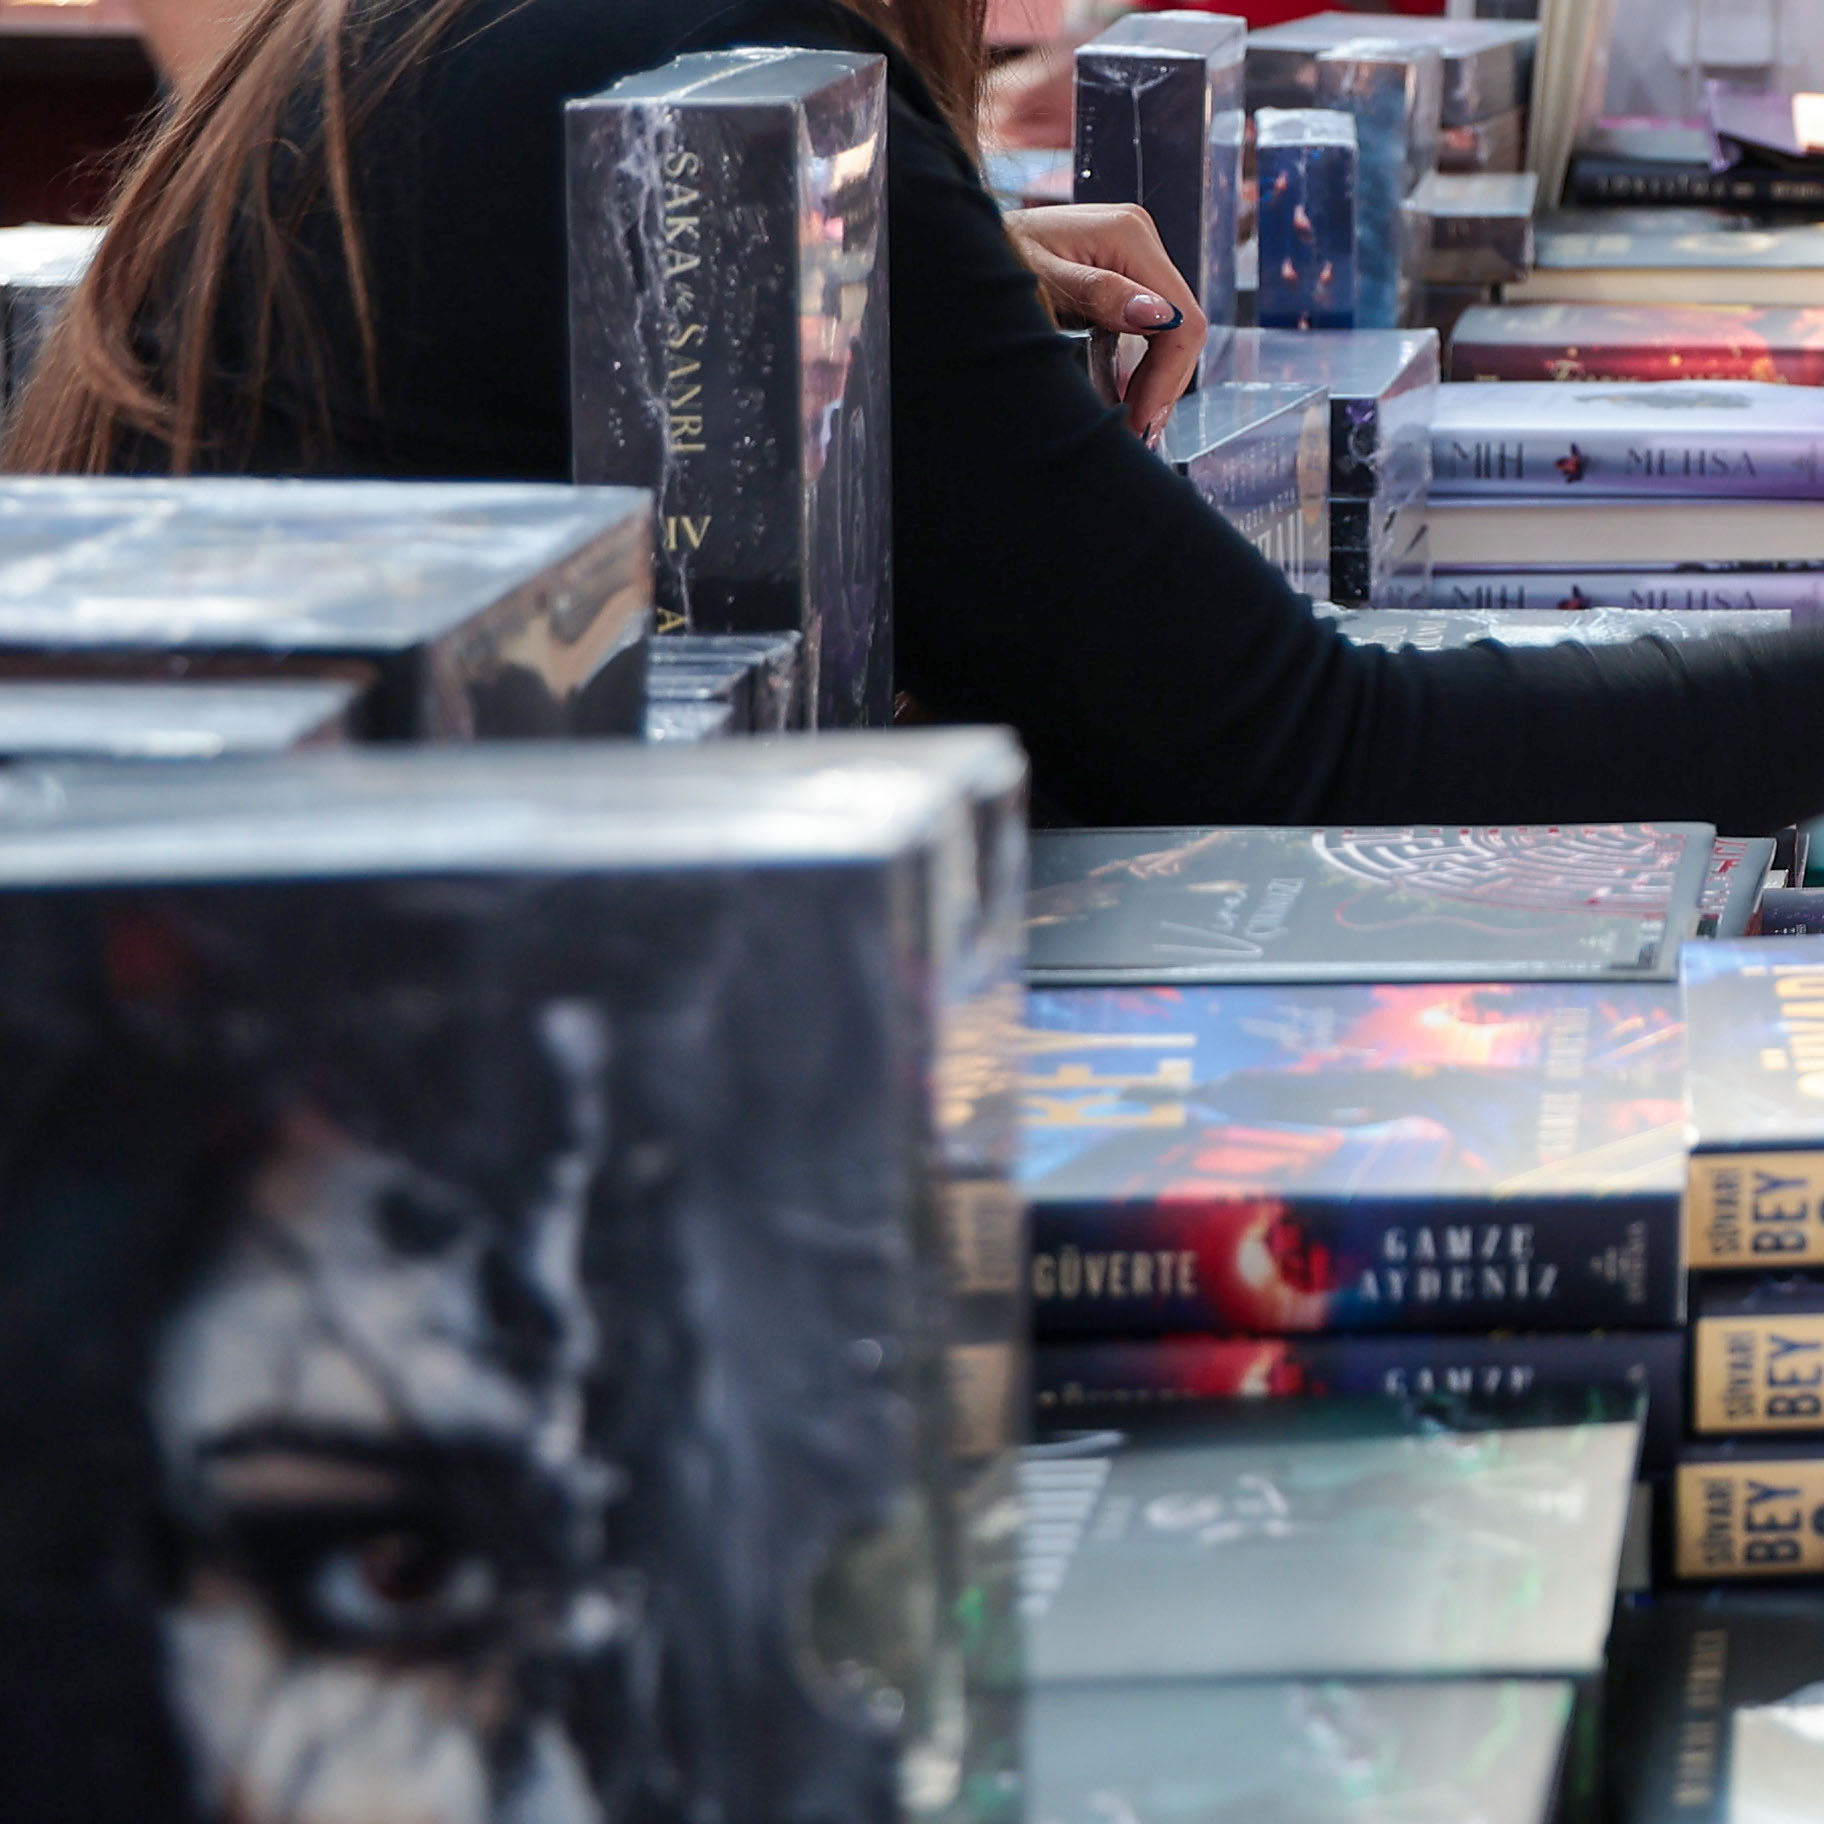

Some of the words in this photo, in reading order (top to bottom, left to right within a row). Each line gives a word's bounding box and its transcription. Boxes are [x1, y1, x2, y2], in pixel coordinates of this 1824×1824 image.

[664, 144, 700, 276] SAKA
[1749, 1168, 1810, 1257] BEY
[1765, 1333, 1824, 1423] BEY
[1743, 1479, 1804, 1569] BEY
